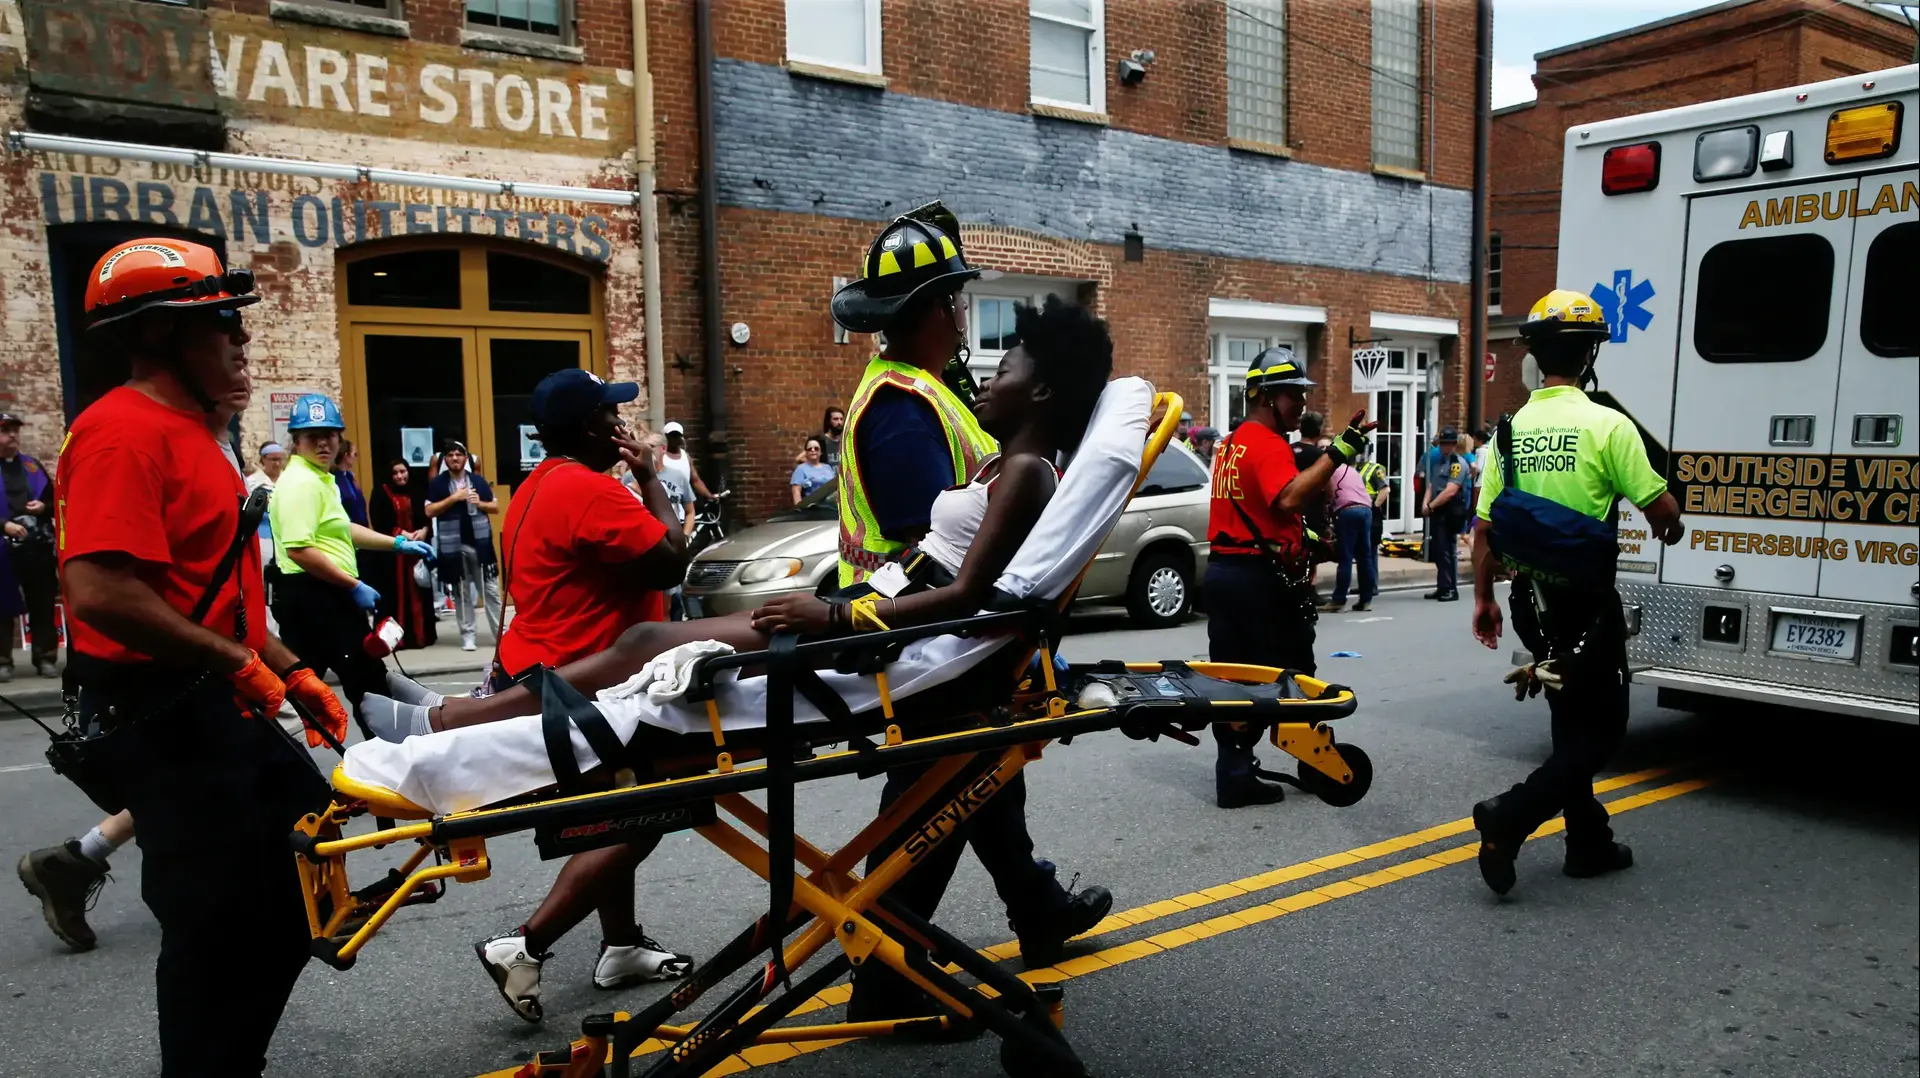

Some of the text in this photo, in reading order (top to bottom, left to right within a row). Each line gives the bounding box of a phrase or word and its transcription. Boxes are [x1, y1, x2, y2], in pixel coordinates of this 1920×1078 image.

[419, 63, 609, 141] STORE
[39, 172, 271, 244] URBAN
[291, 193, 611, 263] OUTFITTERS
[1512, 435, 1578, 455] ESCUE
[1501, 455, 1576, 474] PERVISOR
[1676, 454, 1848, 488] SOUTHSIDE
[1685, 485, 1878, 521] EMERGENCY
[1690, 529, 1848, 561] PETERSBURG
[1786, 624, 1846, 648] EV2382
